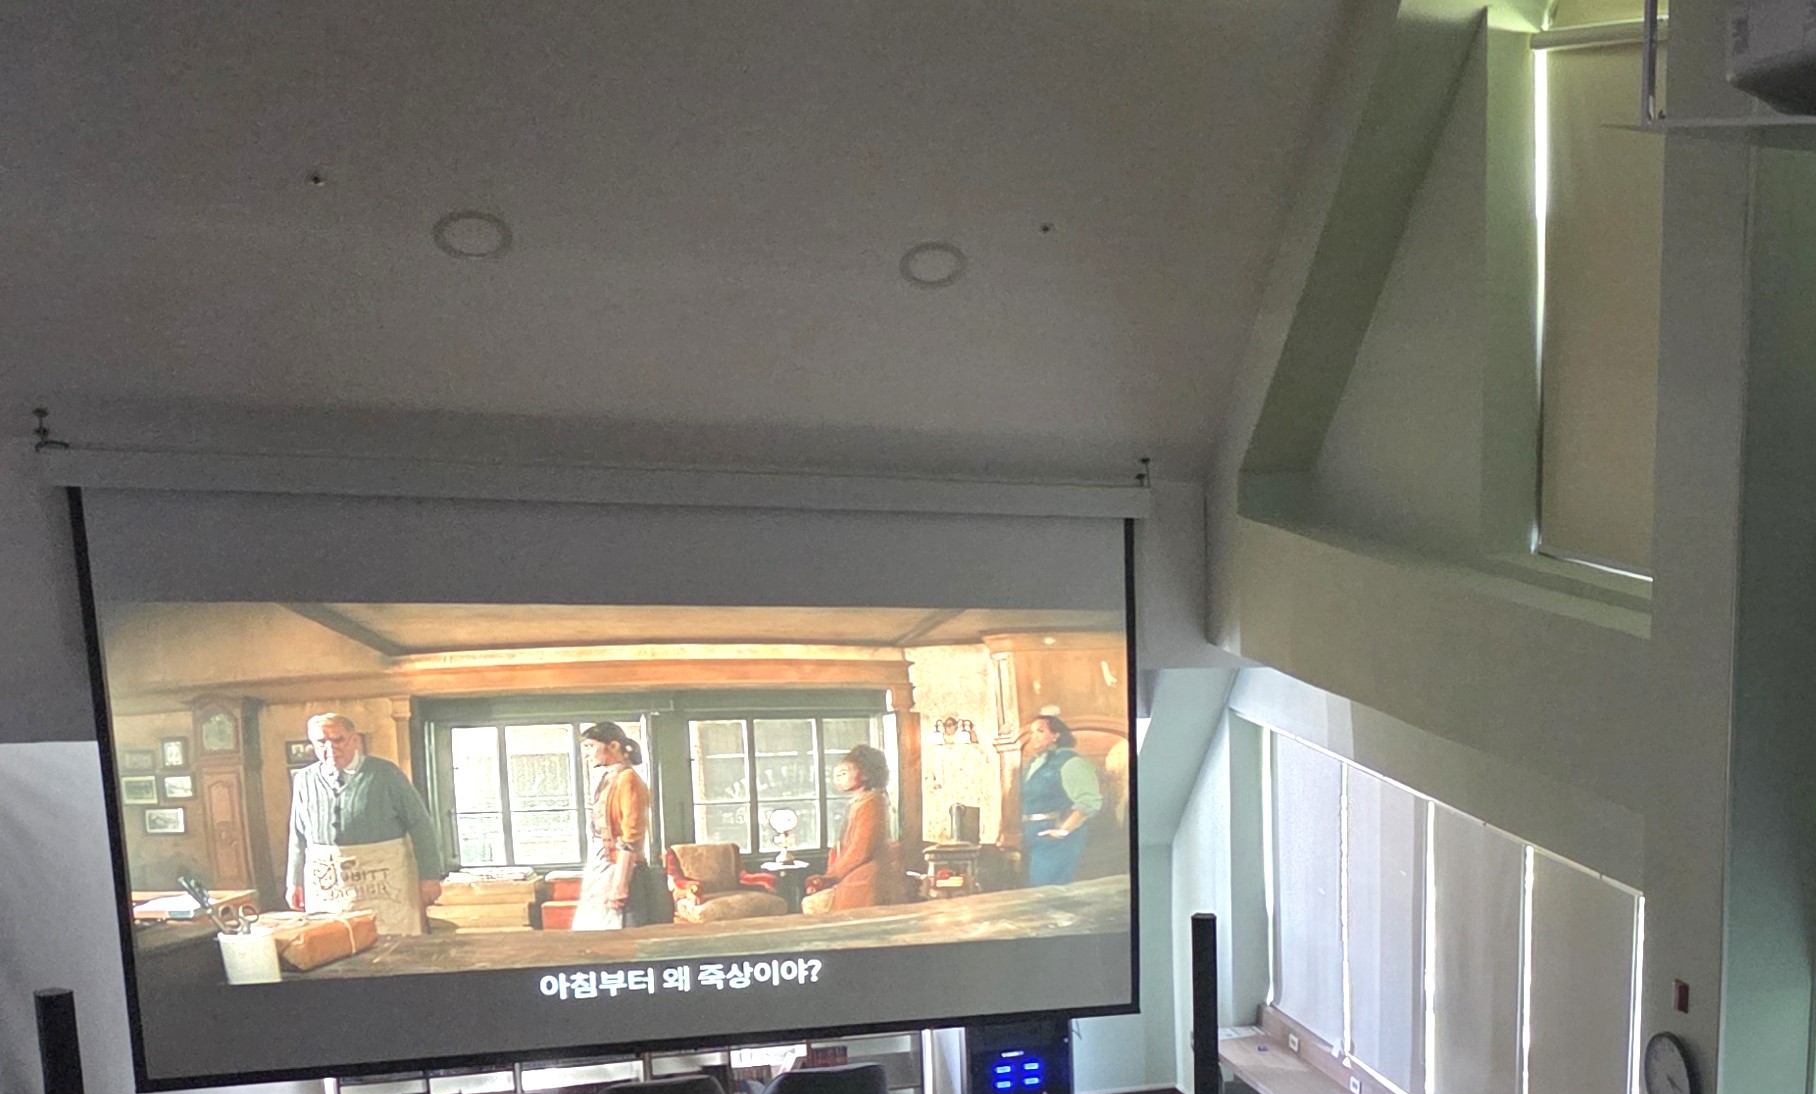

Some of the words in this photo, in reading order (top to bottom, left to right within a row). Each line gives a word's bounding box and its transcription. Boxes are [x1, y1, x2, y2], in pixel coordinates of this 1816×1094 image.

[540, 967, 655, 1000] 아침부터
[662, 965, 691, 992] 왜
[697, 958, 823, 991] 죽상이야?
